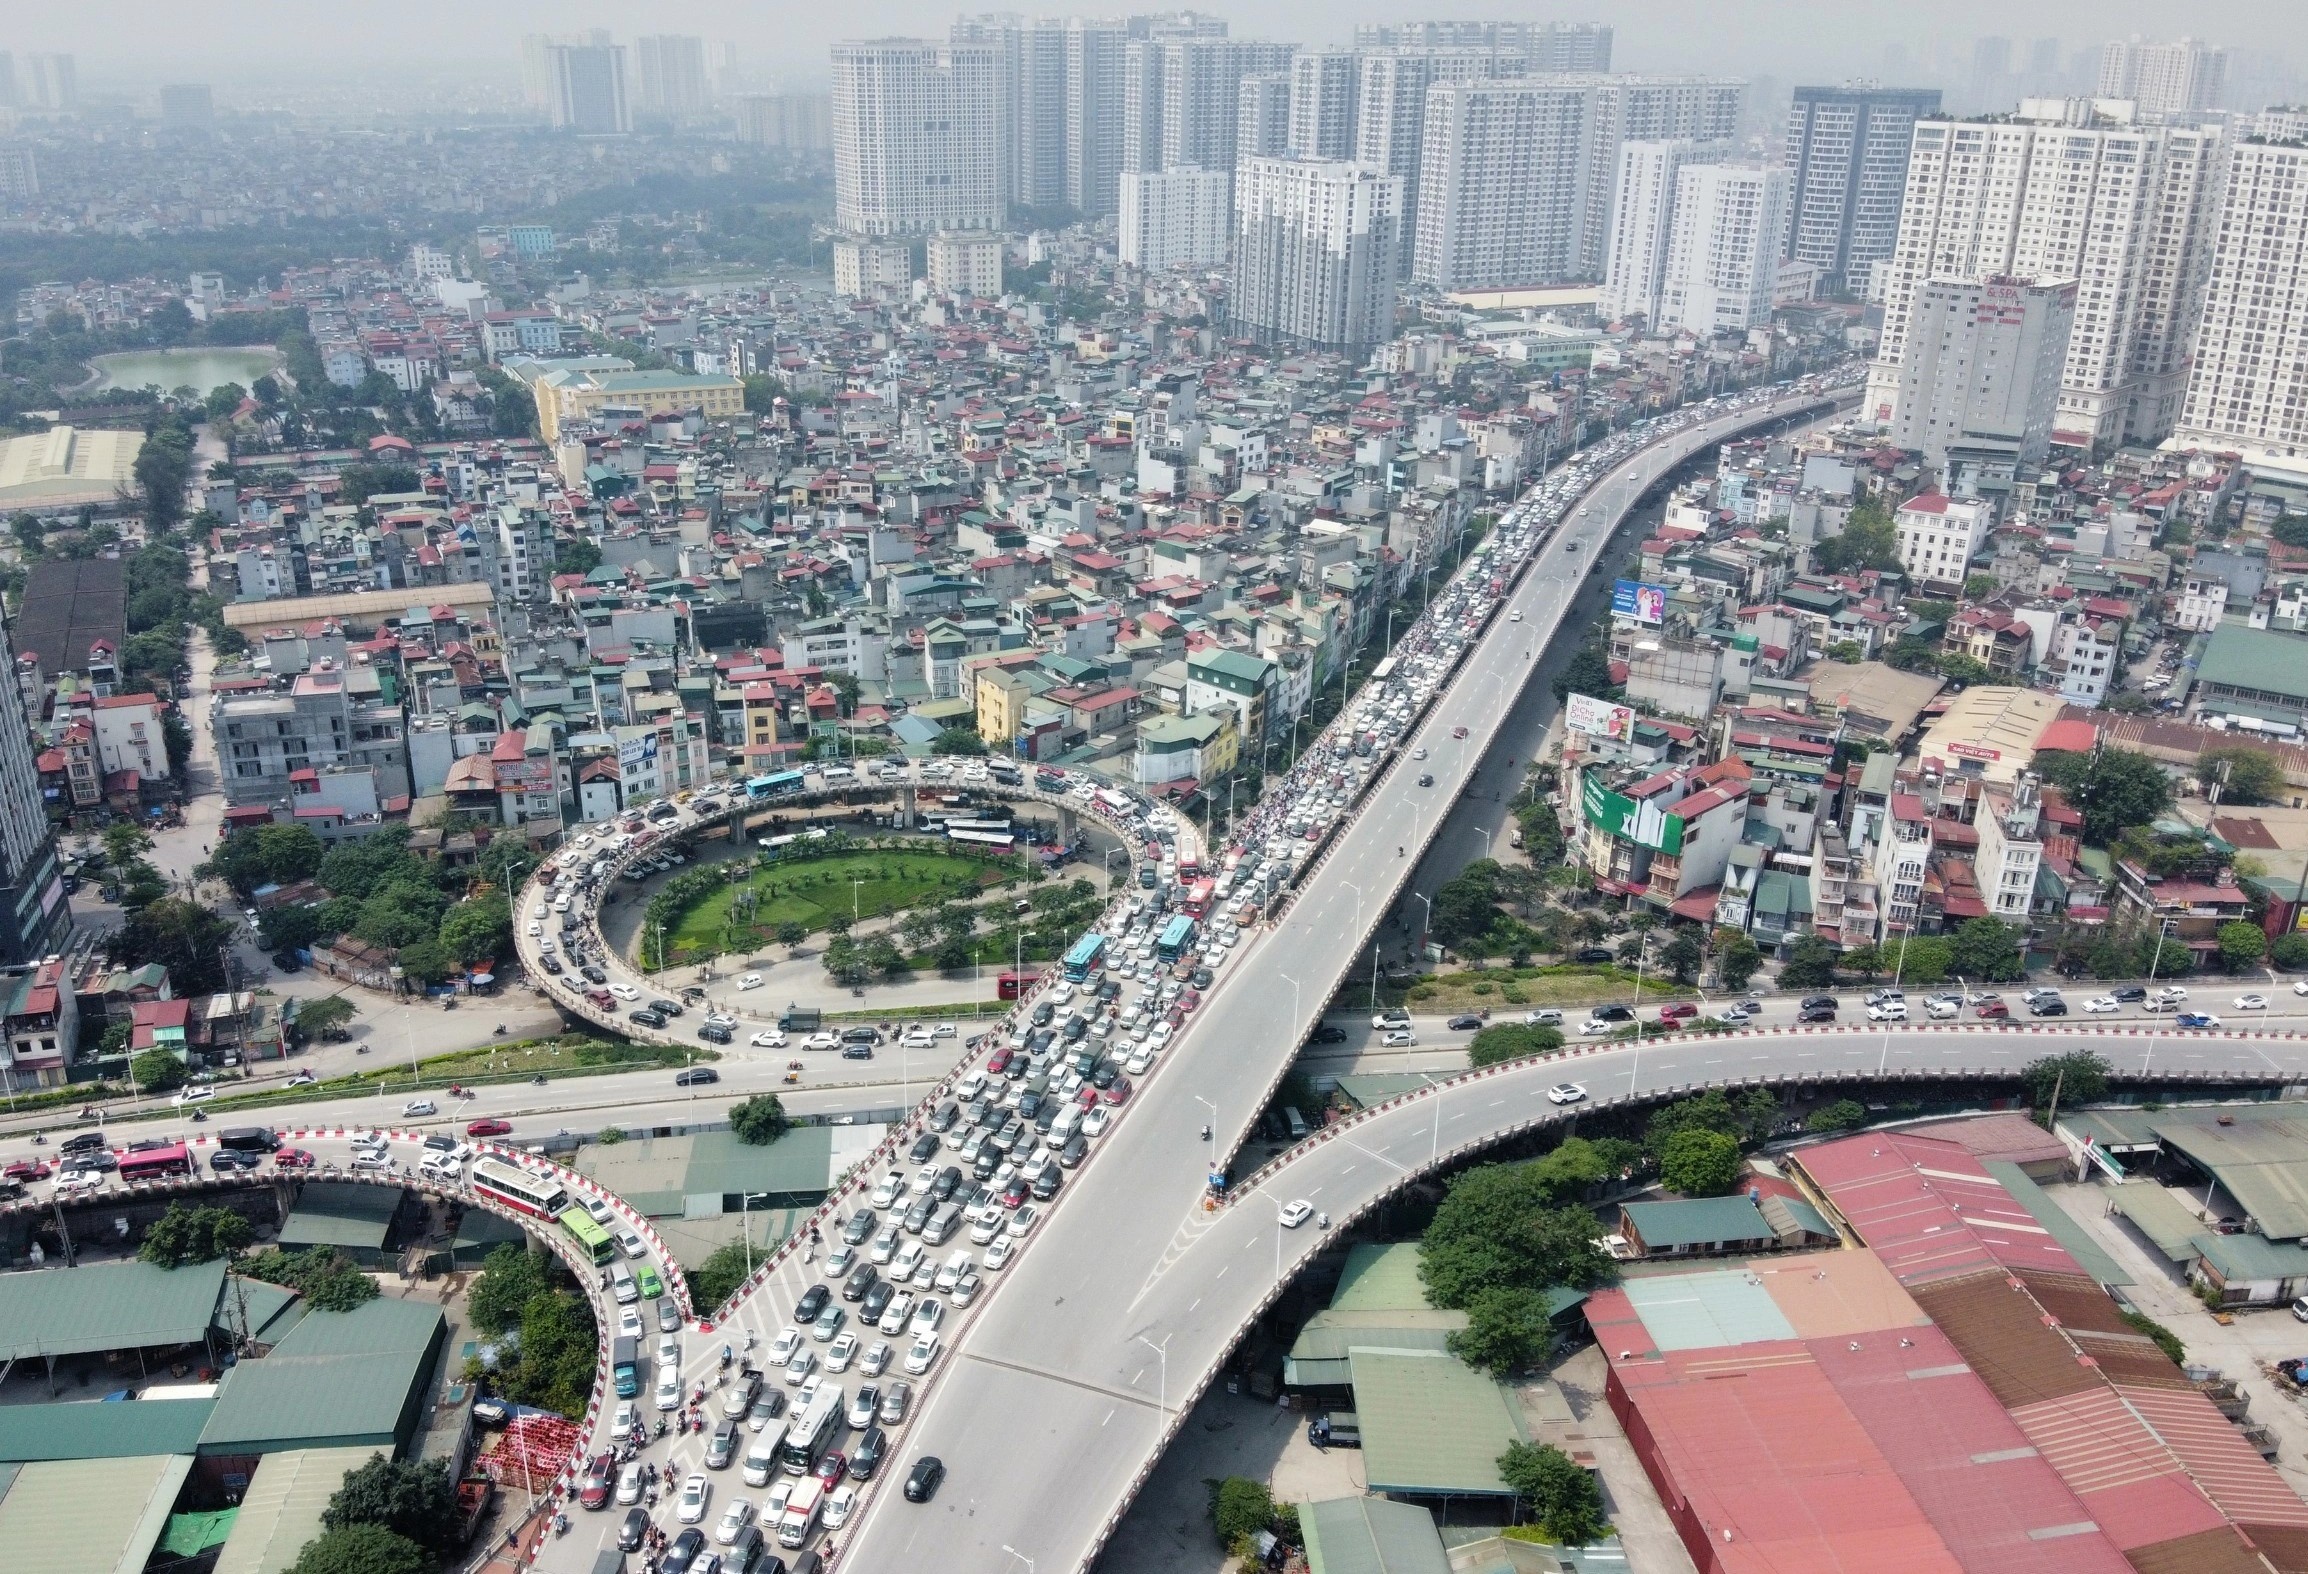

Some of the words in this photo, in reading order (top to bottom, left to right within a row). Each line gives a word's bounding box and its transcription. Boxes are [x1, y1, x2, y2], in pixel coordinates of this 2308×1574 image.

[1987, 288, 1996, 297] &
[1999, 288, 2019, 299] SPA
[1570, 711, 1594, 723] Online
